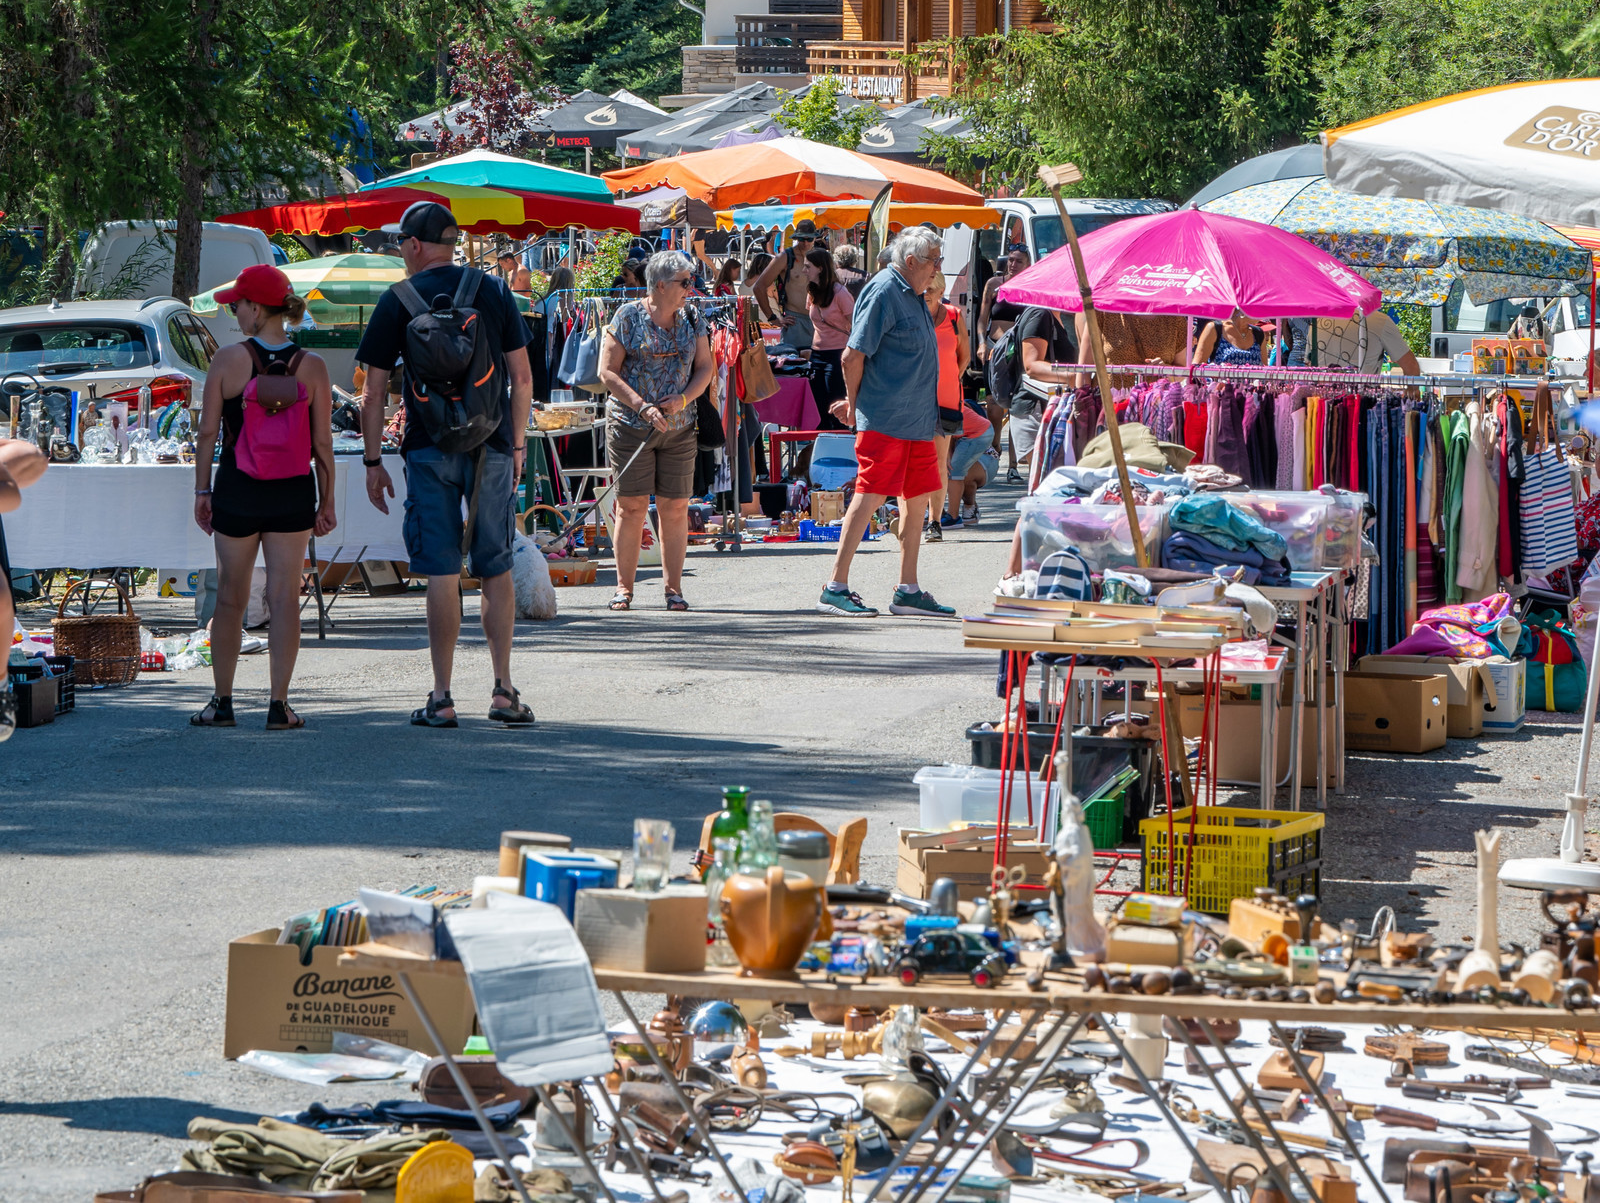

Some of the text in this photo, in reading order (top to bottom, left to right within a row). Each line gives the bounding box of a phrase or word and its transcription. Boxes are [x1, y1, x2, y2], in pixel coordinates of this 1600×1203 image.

[858, 77, 903, 97] RESTAURANT
[557, 137, 591, 147] METEOR
[293, 972, 404, 1000] Banane
[286, 1001, 396, 1015] DE GUADELOUPE
[290, 1012, 390, 1027] & MARTINIQUE
